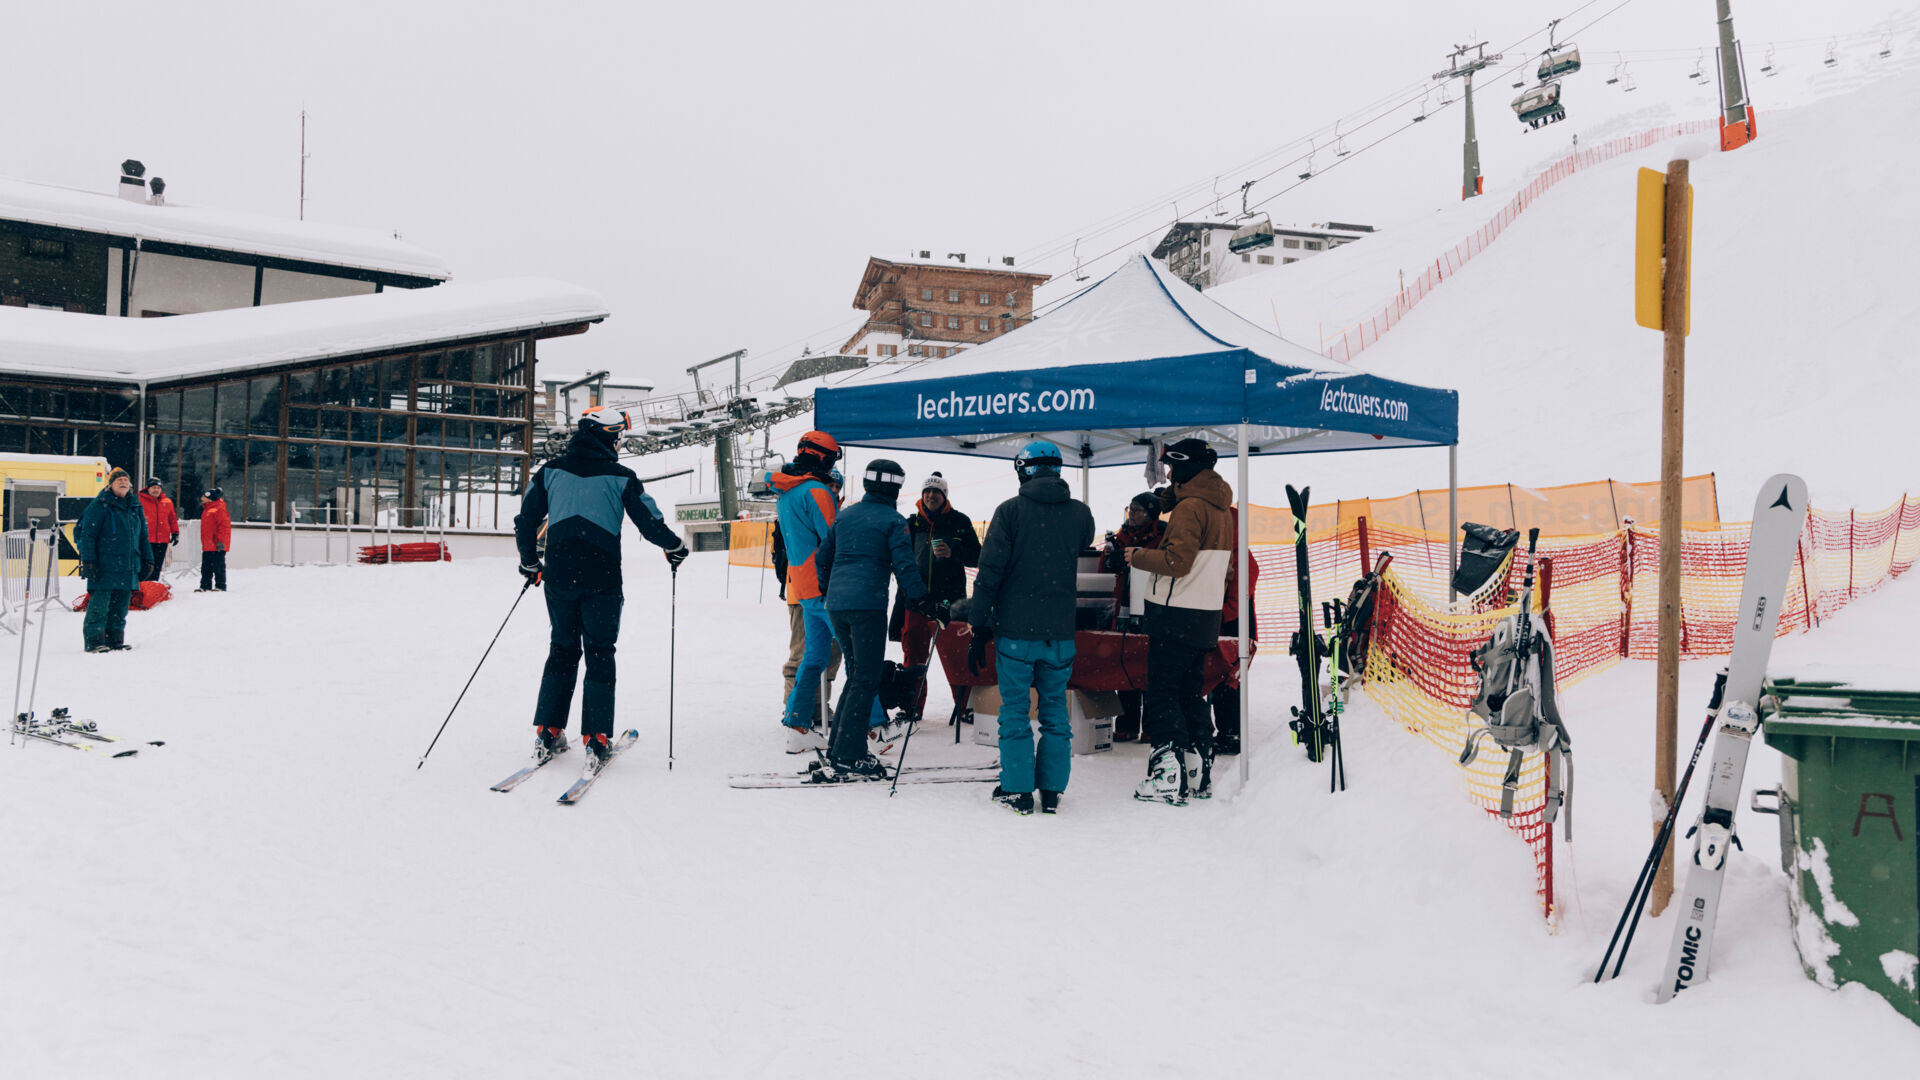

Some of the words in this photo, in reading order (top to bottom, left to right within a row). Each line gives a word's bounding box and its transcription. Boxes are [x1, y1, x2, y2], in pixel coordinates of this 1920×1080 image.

[917, 387, 1095, 420] lechzuers.com
[1320, 382, 1408, 422] lechzuers.com
[1852, 793, 1903, 842] A
[1672, 926, 1702, 999] TOMIC
